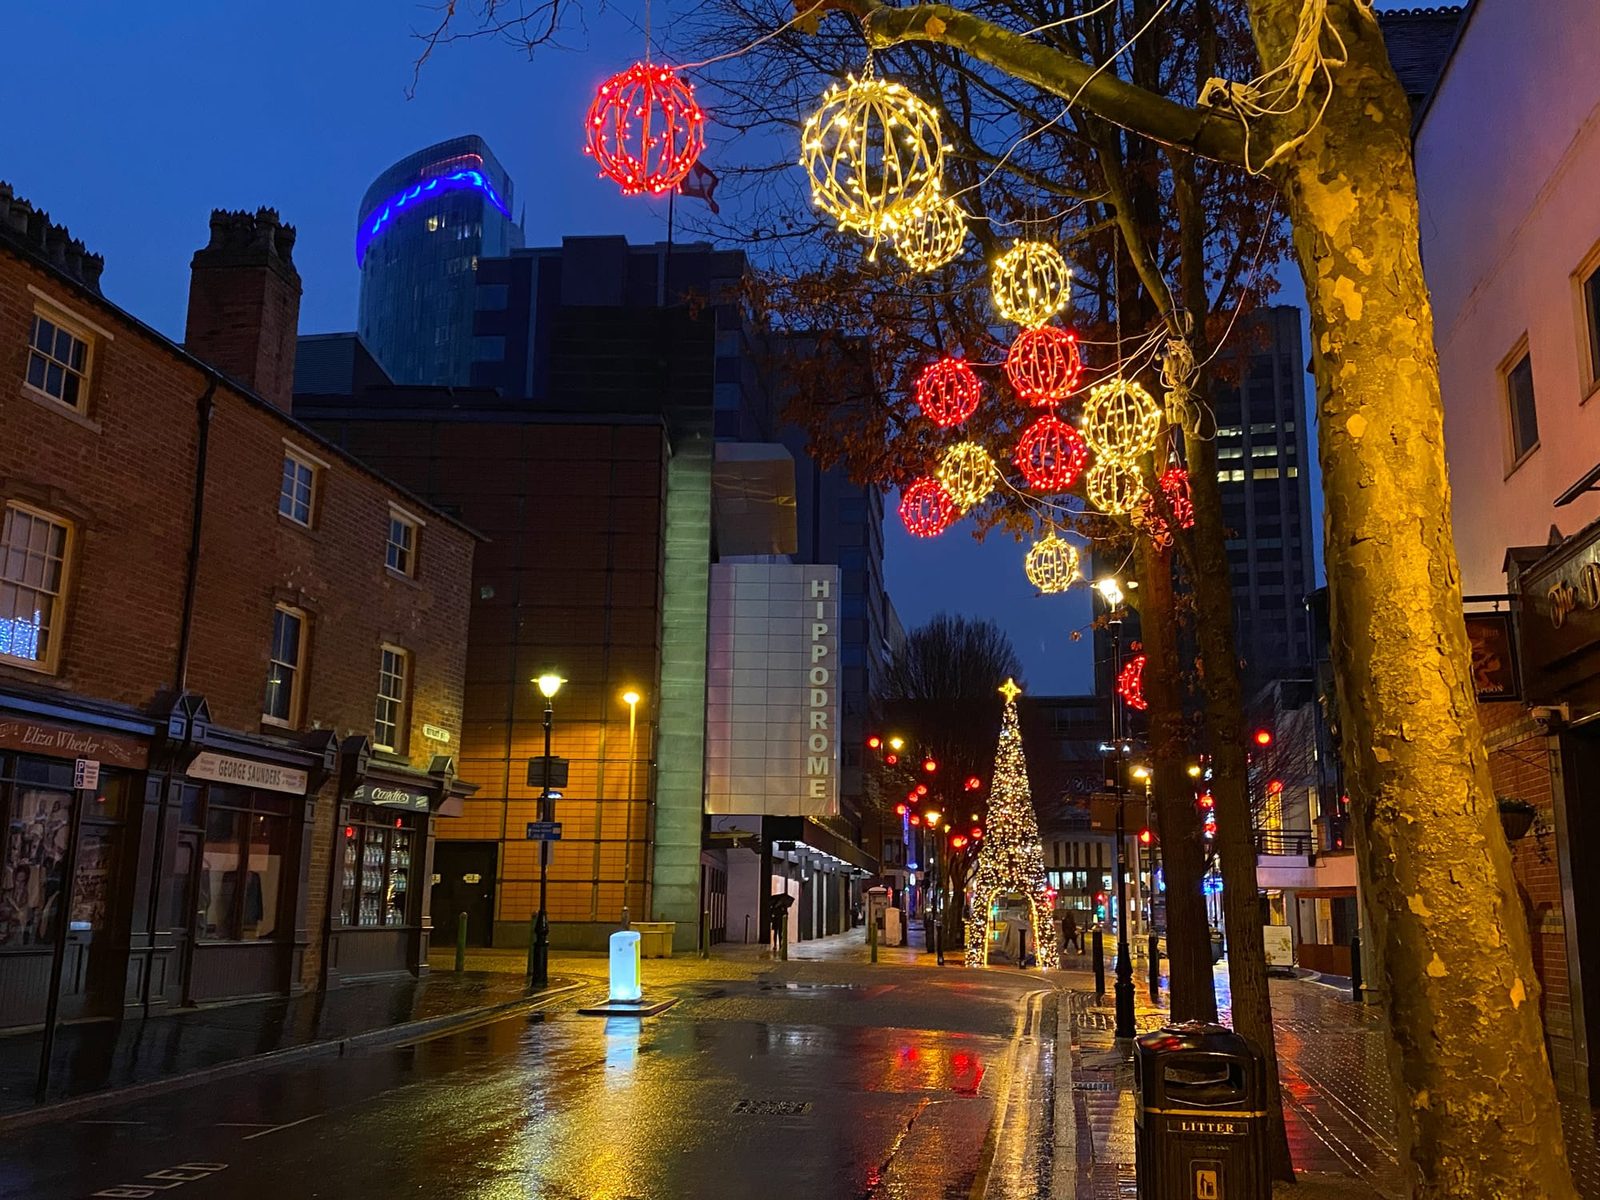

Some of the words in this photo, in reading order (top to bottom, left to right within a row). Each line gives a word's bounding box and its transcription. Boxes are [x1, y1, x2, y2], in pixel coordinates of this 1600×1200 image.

[1547, 581, 1575, 629] The
[807, 580, 830, 798] HIPPODROME
[21, 726, 54, 746] Eliza
[56, 731, 99, 753] Wheeler
[218, 760, 246, 780] GEORGE
[247, 765, 281, 786] SAUNDERS
[371, 787, 410, 804] Candies
[1182, 1122, 1235, 1132] LITTER
